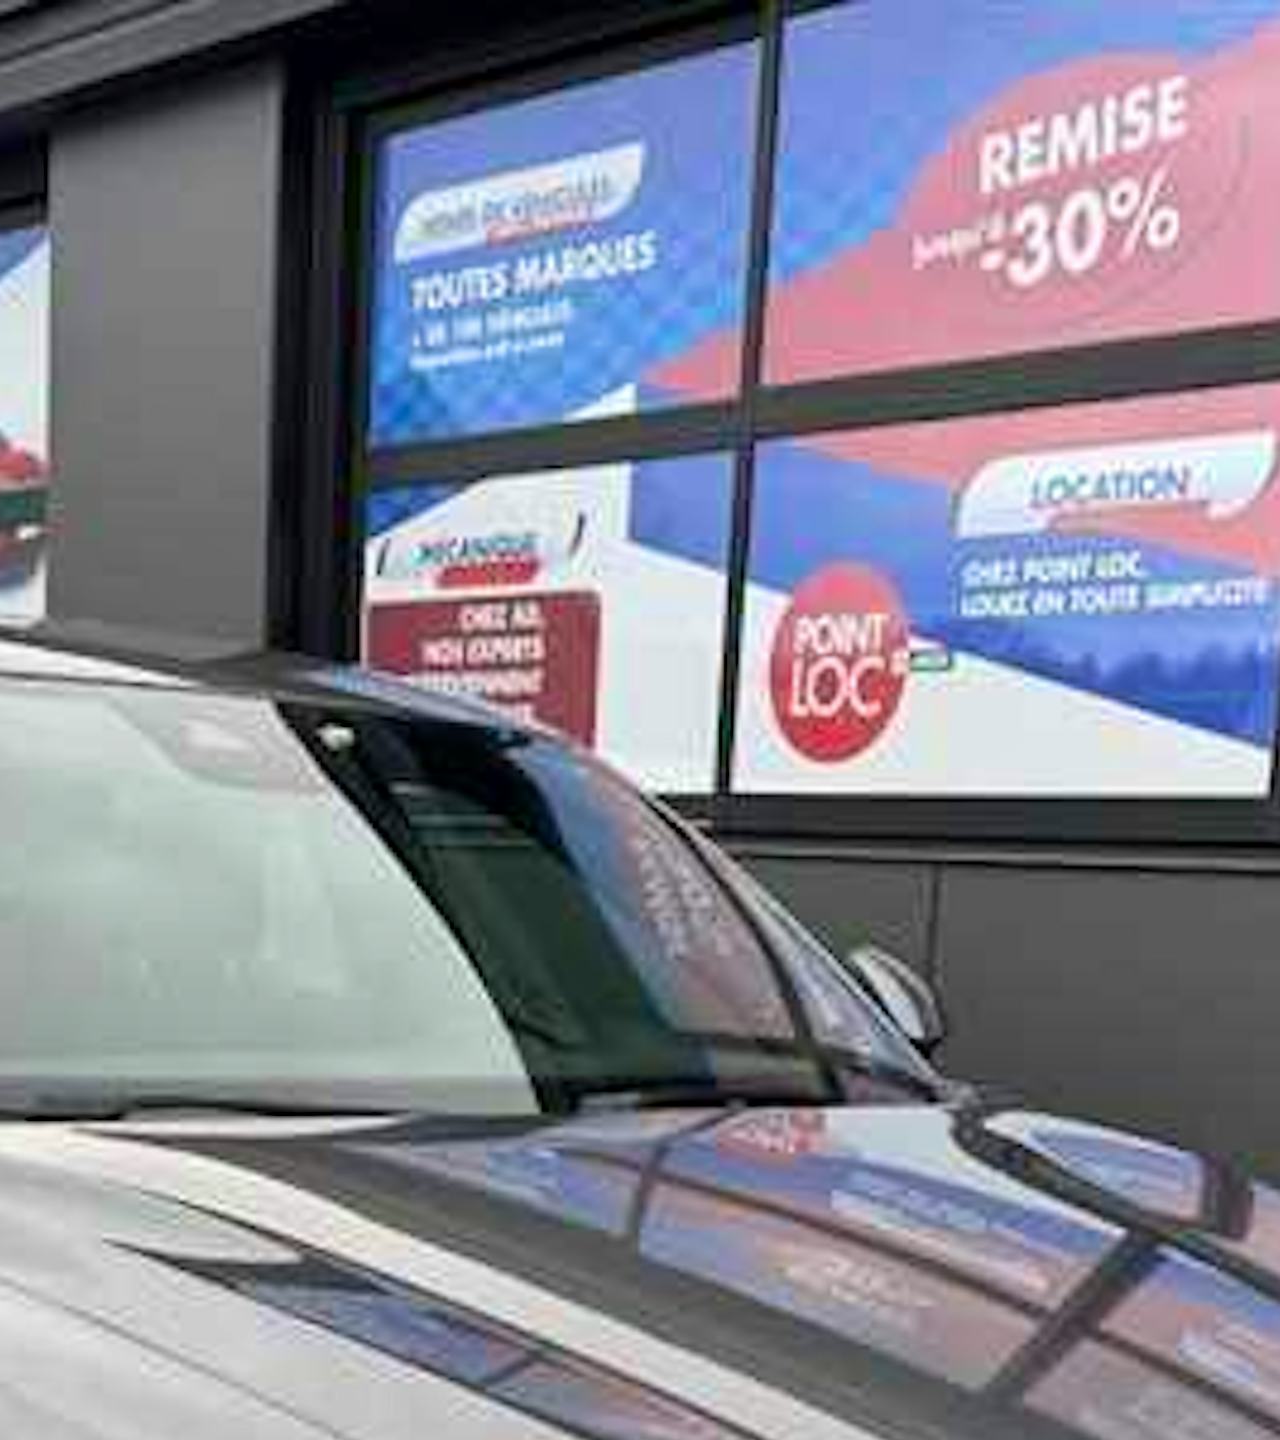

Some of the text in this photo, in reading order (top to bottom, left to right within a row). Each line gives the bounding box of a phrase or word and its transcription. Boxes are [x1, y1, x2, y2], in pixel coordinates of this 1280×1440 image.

[978, 74, 1189, 195] REMISE
[412, 228, 659, 309] TOUTES MARQUES
[1028, 463, 1187, 507] LOCATION
[1022, 552, 1093, 583] POINT
[793, 612, 890, 656] POINT
[789, 655, 888, 718] LOC
